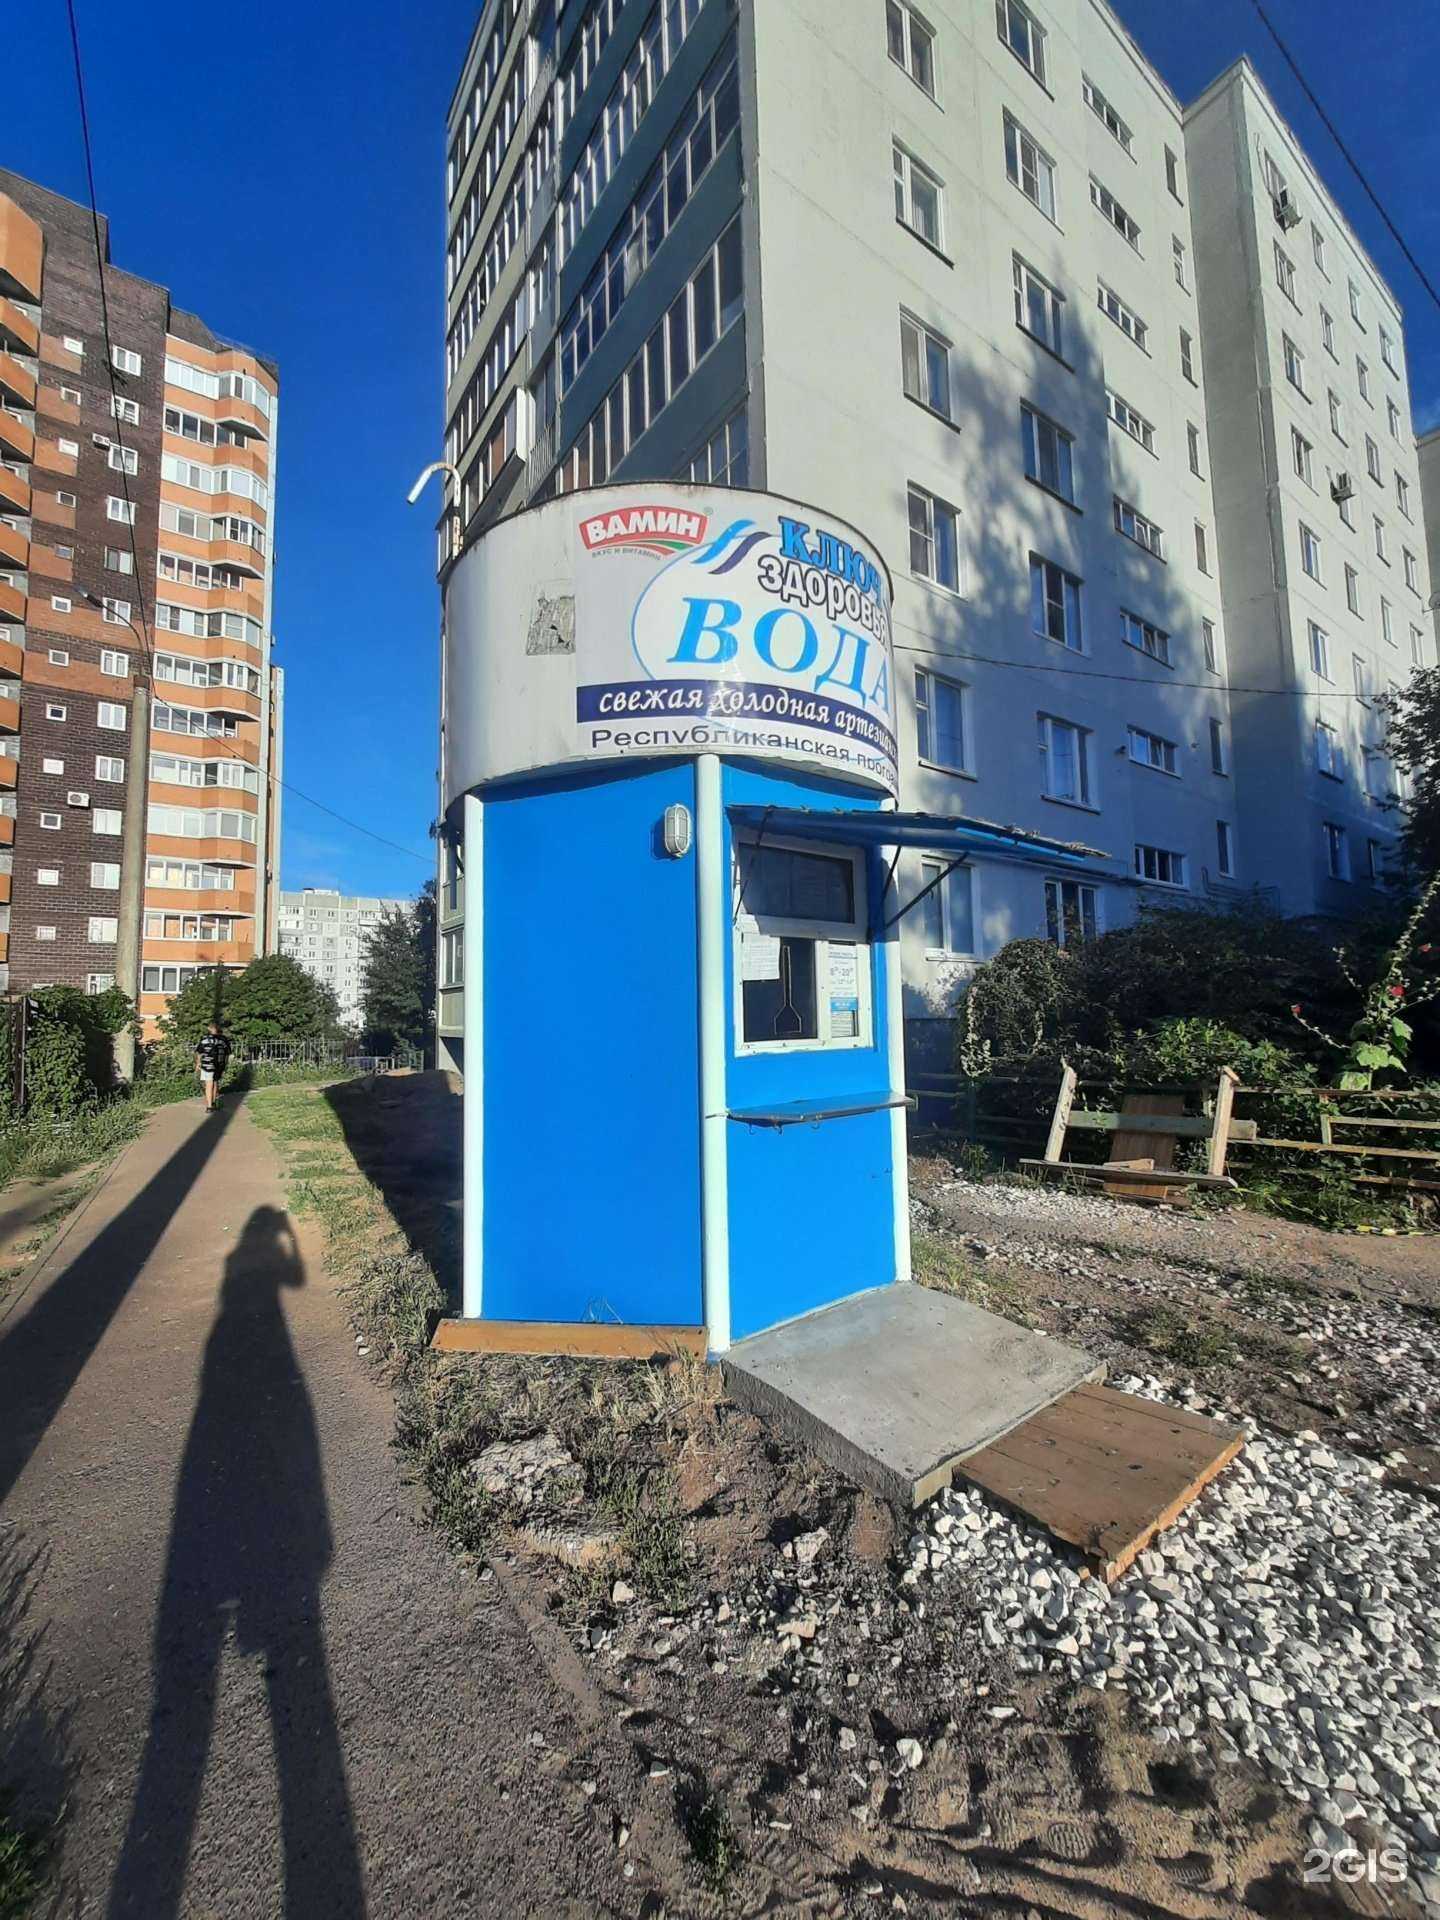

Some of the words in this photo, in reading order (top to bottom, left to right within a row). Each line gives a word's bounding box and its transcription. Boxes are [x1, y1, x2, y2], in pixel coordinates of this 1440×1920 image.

[586, 510, 700, 544] ВАМИН
[777, 515, 881, 612] КЛЮЧ
[757, 554, 889, 650] ЗДОРОВЬЯ
[666, 597, 890, 714] ВОДА
[599, 688, 704, 713] свежая
[708, 686, 830, 724] холодная
[591, 725, 850, 762] Республиканская
